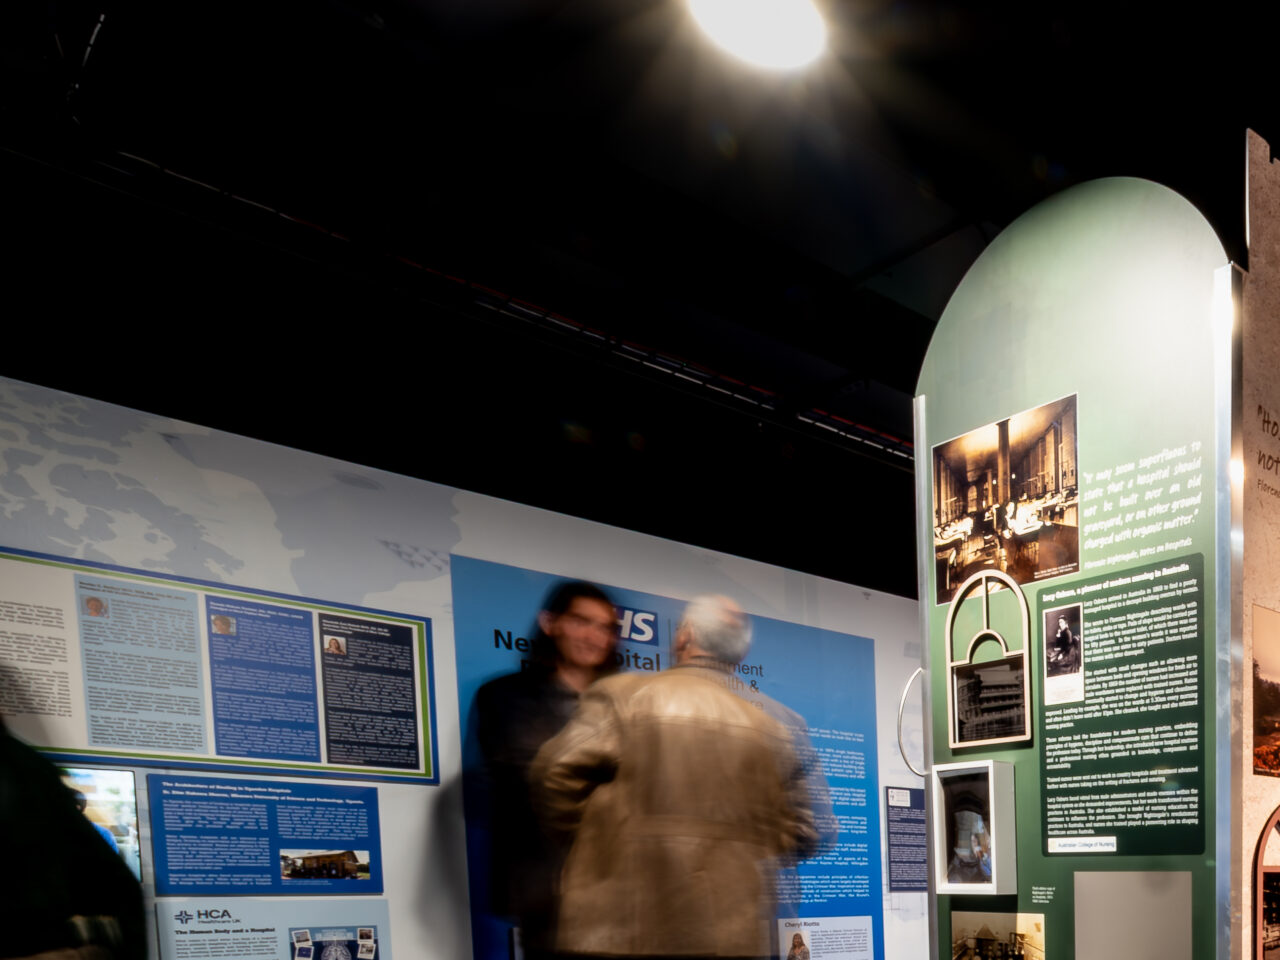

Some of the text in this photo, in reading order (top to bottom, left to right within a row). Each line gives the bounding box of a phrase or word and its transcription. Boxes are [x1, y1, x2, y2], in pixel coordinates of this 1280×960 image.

[1191, 441, 1201, 452] to
[1137, 466, 1170, 485] hospital
[1174, 456, 1201, 475] should
[1257, 449, 1280, 475] not
[1171, 492, 1202, 512] ground
[197, 909, 232, 919] HCA
